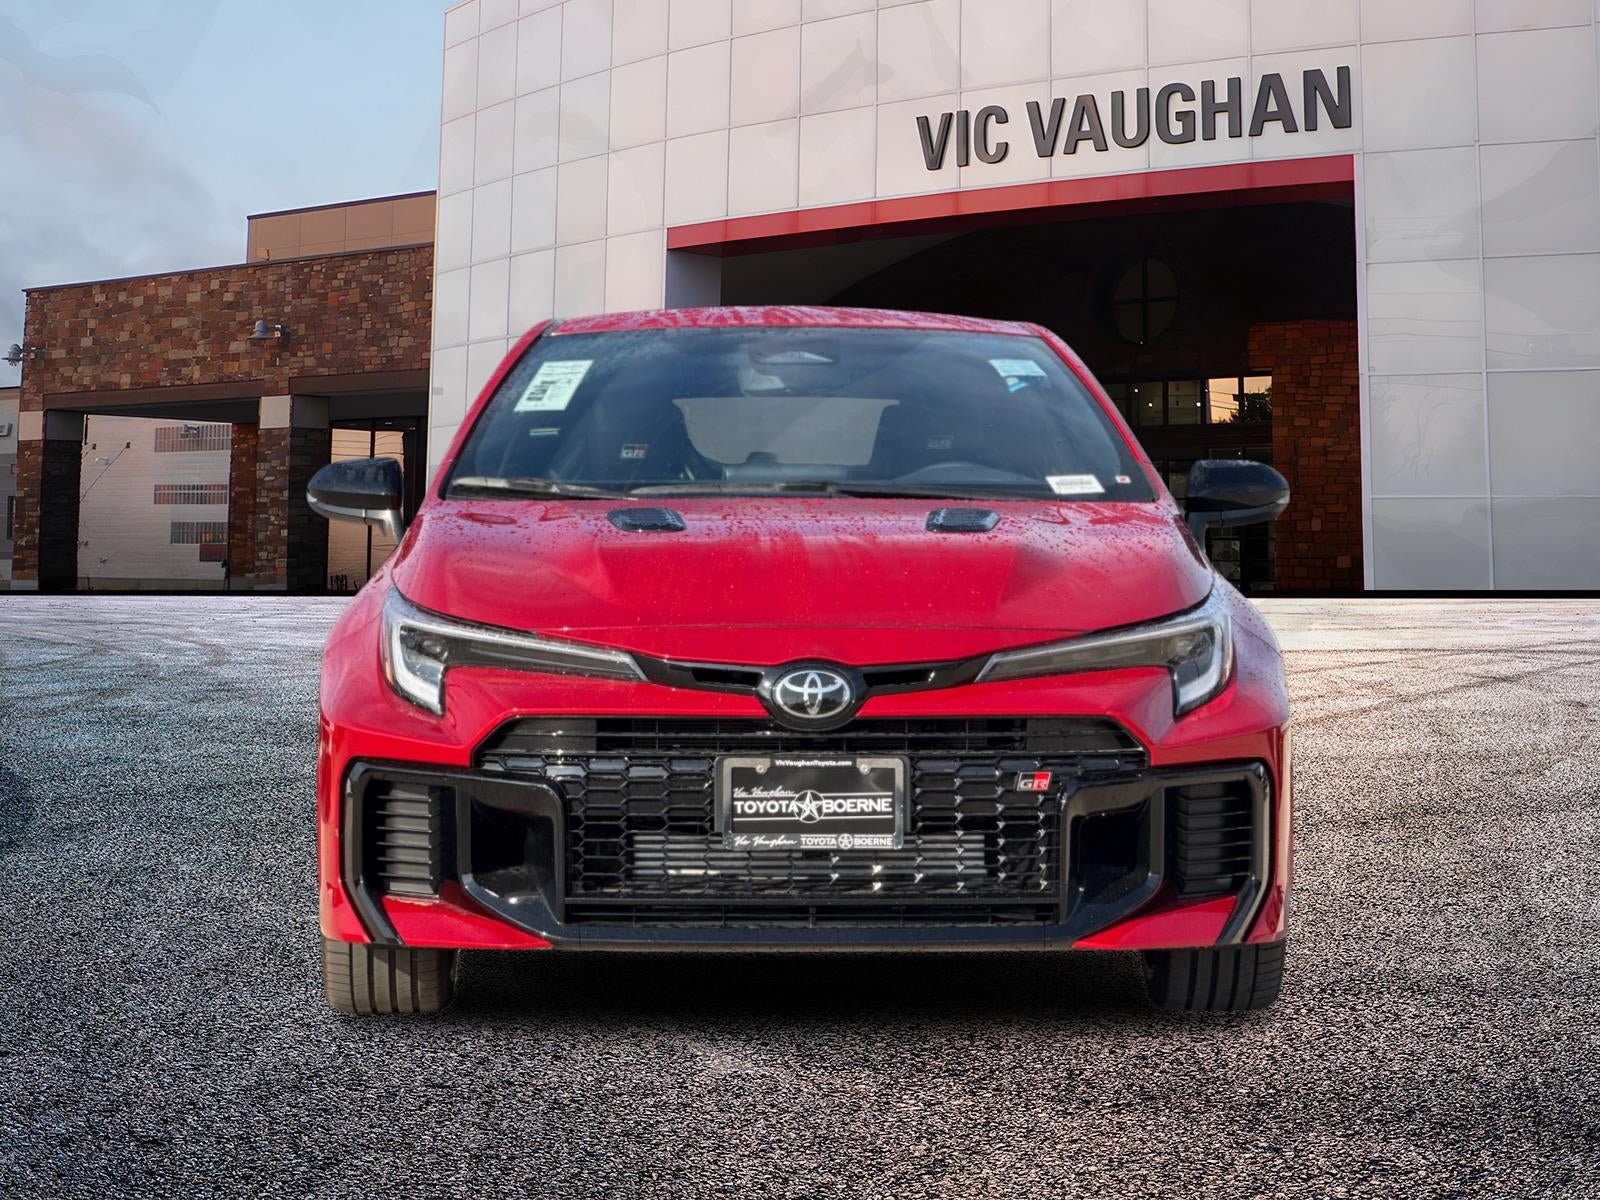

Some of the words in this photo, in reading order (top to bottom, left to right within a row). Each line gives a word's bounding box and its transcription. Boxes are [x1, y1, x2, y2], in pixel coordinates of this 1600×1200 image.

[916, 105, 1009, 171] VIC
[1026, 65, 1352, 158] VAUGHAN
[621, 448, 646, 459] GR
[775, 759, 852, 767] VicVaughanToyota.com
[1018, 778, 1050, 791] GR
[733, 800, 798, 814] TOYOTA
[822, 798, 893, 813] BOERNE
[800, 837, 837, 846] TOYOTA
[854, 837, 893, 846] BOERNE
